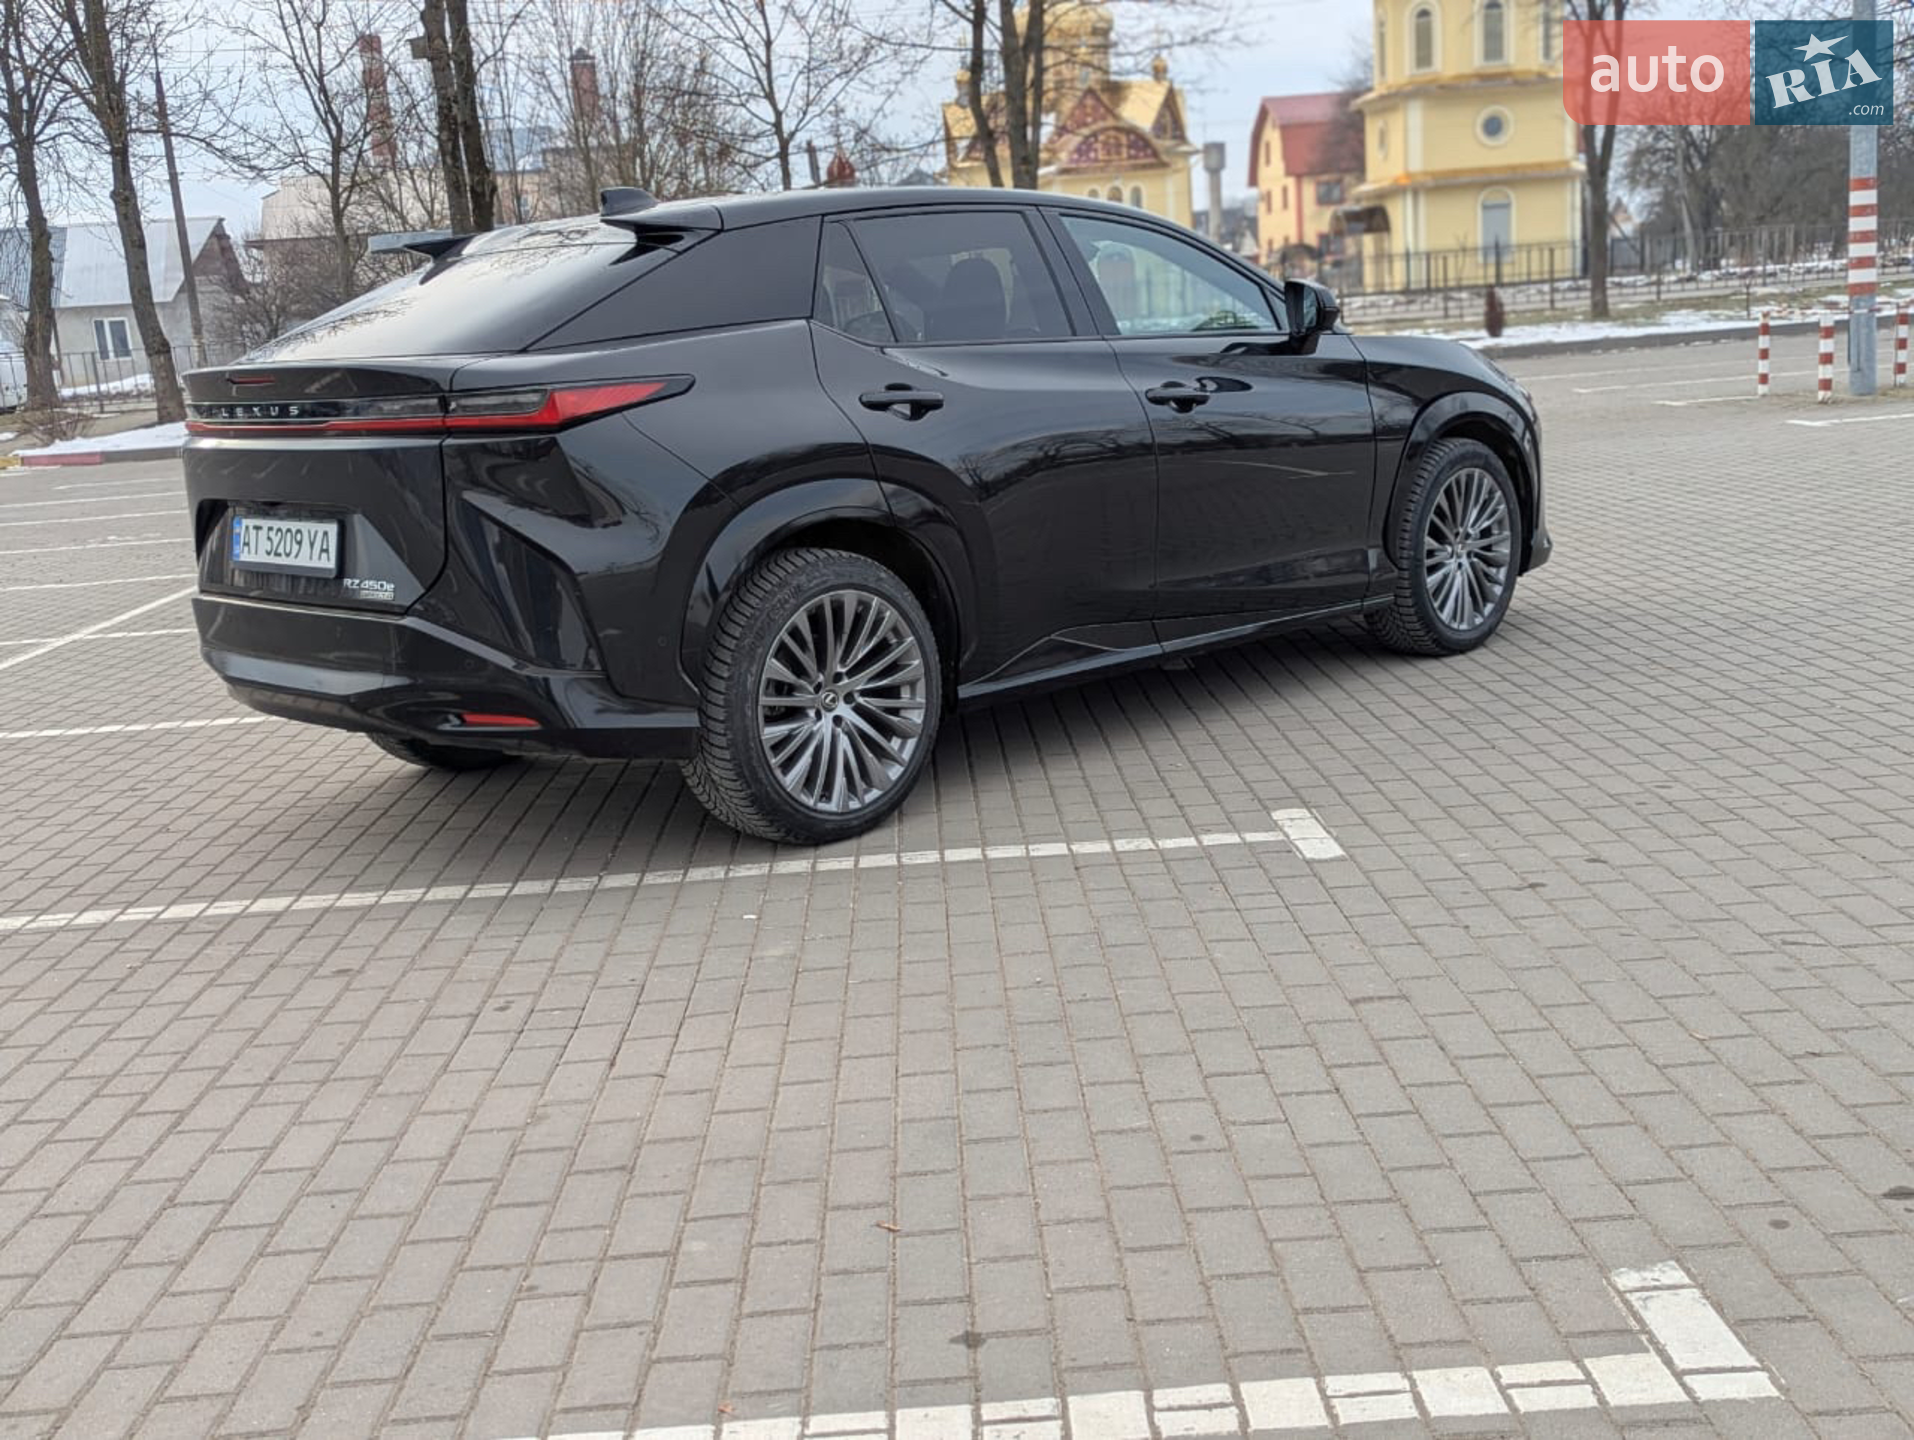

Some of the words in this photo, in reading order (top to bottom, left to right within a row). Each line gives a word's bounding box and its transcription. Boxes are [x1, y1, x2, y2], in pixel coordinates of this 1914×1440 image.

[221, 405, 299, 417] LEXUS
[241, 525, 263, 555] AT
[265, 526, 303, 559] 5209
[308, 529, 330, 562] YA
[343, 578, 360, 588] RZ
[360, 579, 395, 591] 450e
